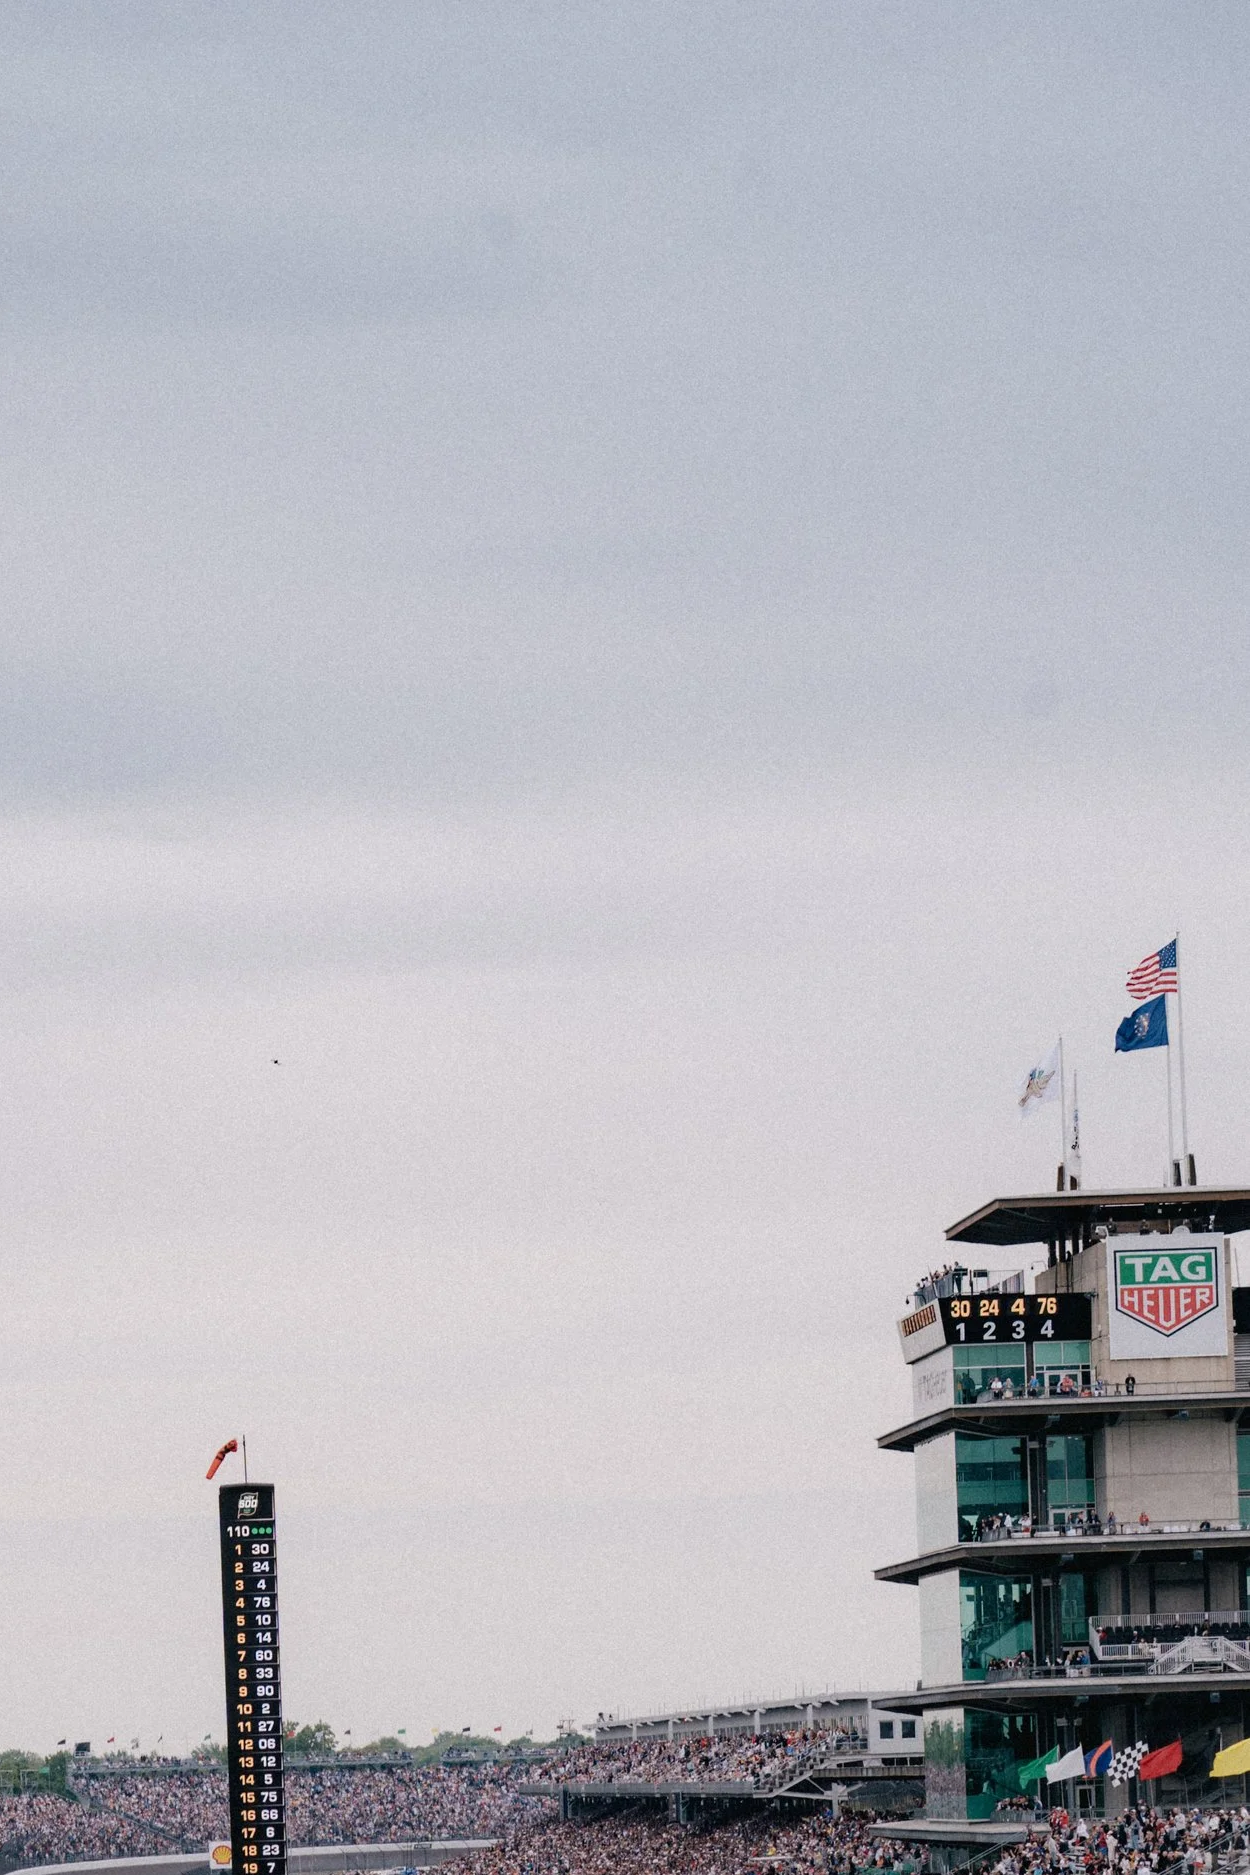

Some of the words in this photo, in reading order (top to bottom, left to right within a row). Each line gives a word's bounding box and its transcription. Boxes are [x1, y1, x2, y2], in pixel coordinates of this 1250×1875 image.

[1125, 1255, 1206, 1283] TAG
[950, 1300, 971, 1319] 30
[979, 1299, 1000, 1317] 24
[1010, 1298, 1026, 1316] 4
[1037, 1297, 1058, 1315] 76
[1122, 1286, 1212, 1328] HEUER
[955, 1322, 966, 1341] 1
[983, 1321, 997, 1340] 2
[1011, 1319, 1025, 1339] 3
[1040, 1318, 1054, 1338] 4
[239, 1499, 258, 1508] 500
[227, 1525, 250, 1538] 110
[234, 1545, 242, 1556] 1
[251, 1544, 270, 1555] 30
[234, 1562, 244, 1574] 2
[252, 1561, 270, 1573] 24
[235, 1580, 245, 1591] 3
[256, 1579, 267, 1591] 4
[235, 1598, 245, 1609] 4
[253, 1597, 271, 1609] 76
[236, 1615, 246, 1627] 5
[255, 1615, 272, 1626] 10
[236, 1633, 246, 1644] 6
[255, 1632, 272, 1644] 14
[237, 1651, 247, 1662] 7
[238, 1669, 248, 1680] 8
[255, 1668, 274, 1680] 33
[238, 1686, 248, 1698] 9
[256, 1685, 275, 1697] 90
[236, 1704, 253, 1715] 10
[261, 1703, 271, 1715] 2
[237, 1721, 252, 1733] 11
[257, 1721, 275, 1732] 27
[238, 1739, 254, 1751] 12
[238, 1757, 255, 1768] 13
[260, 1756, 277, 1768] 12
[239, 1775, 255, 1786] 14
[264, 1774, 273, 1785] 5
[239, 1792, 256, 1804] 15
[260, 1791, 278, 1803] 75
[240, 1810, 257, 1822] 16
[241, 1828, 257, 1839] 17
[265, 1827, 275, 1838] 6
[241, 1845, 258, 1857] 18
[262, 1844, 280, 1856] 23
[242, 1863, 259, 1874] 19
[266, 1862, 276, 1874] 7
